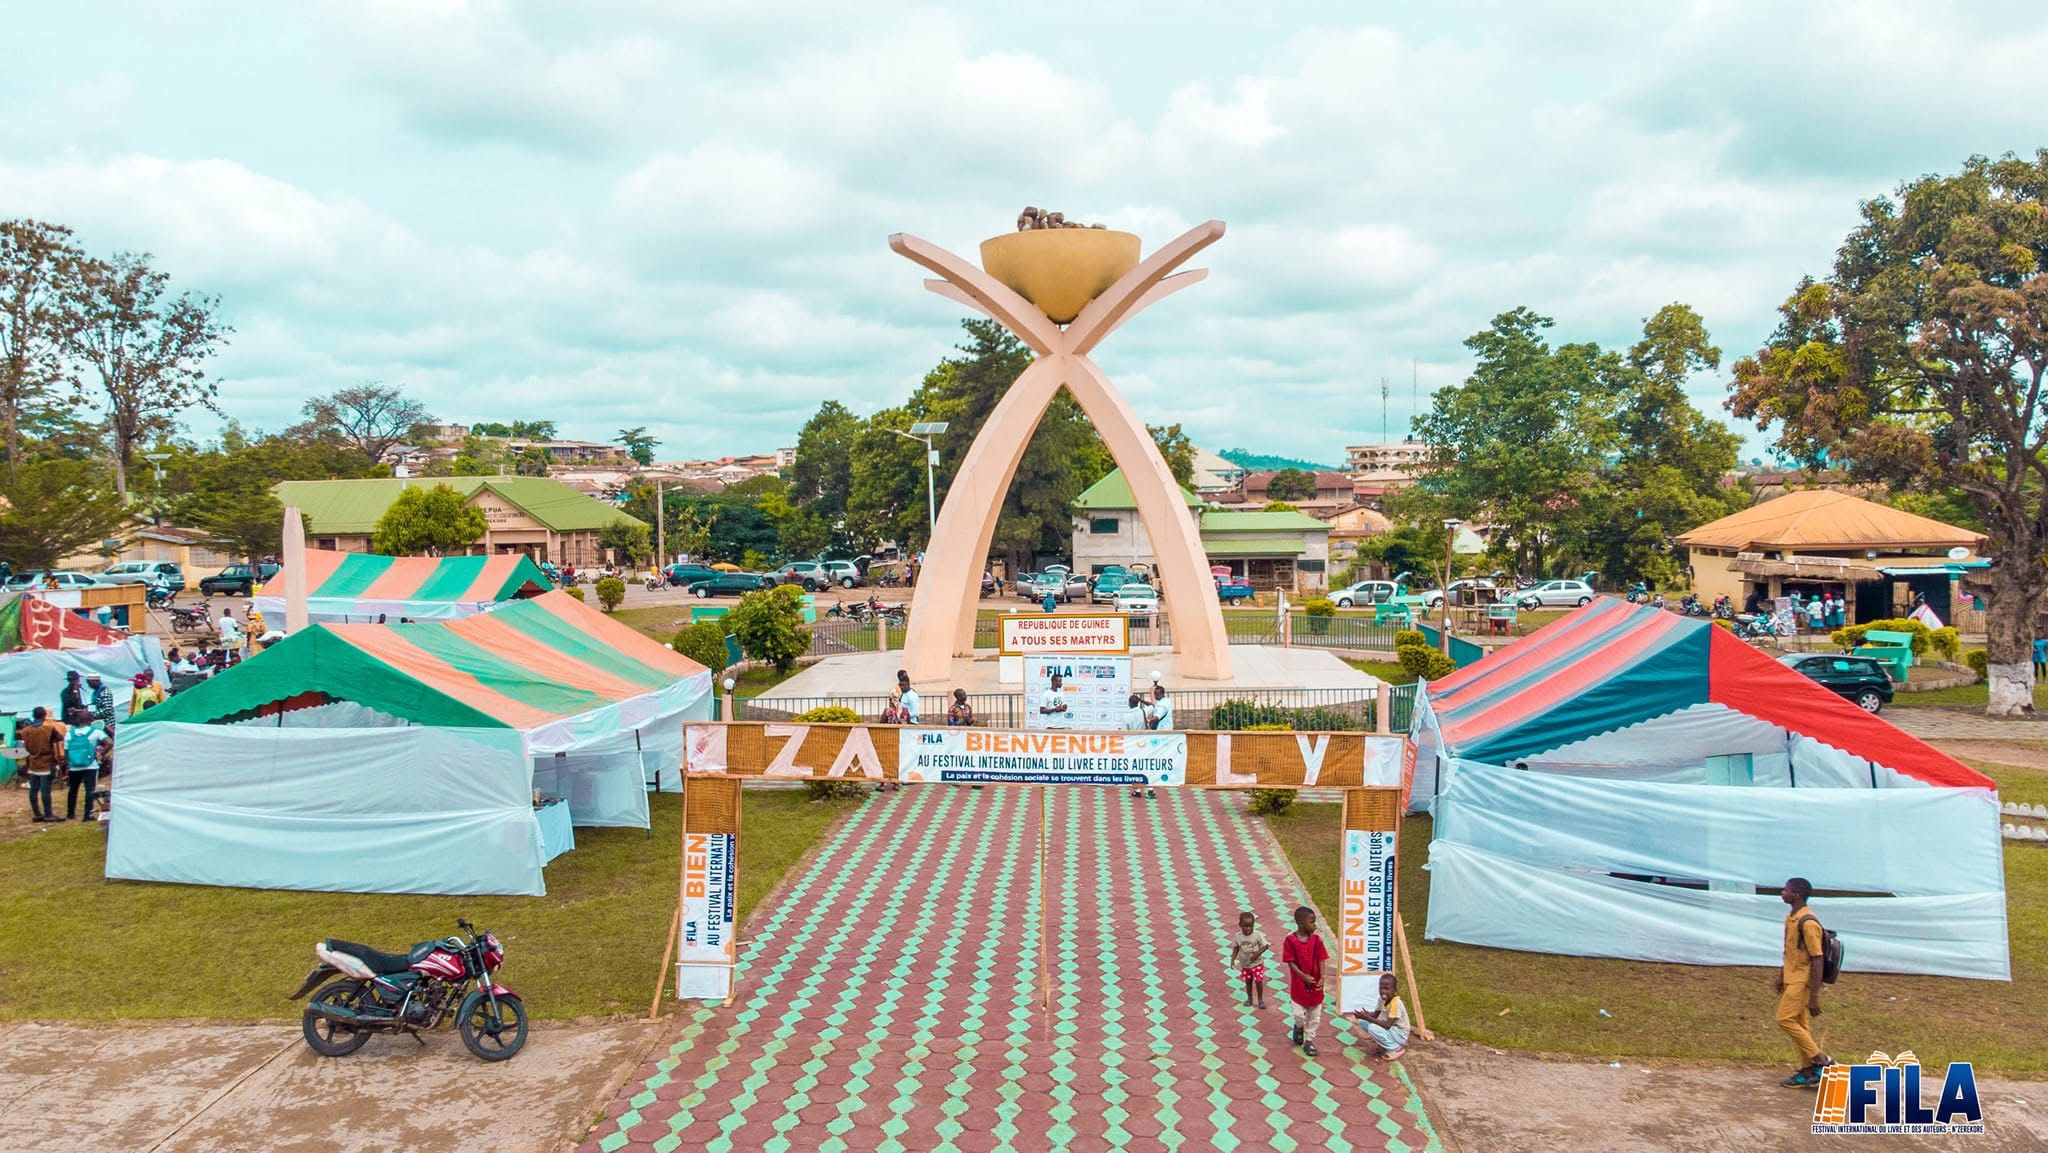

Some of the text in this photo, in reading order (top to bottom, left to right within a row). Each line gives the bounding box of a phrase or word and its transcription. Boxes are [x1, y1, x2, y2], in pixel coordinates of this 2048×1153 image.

[1018, 619, 1110, 630] REPUBLIQUE DE GUINEE
[1011, 635, 1116, 645] A TOUS SES MARTYRS
[966, 732, 1124, 754] BIENVENUE
[917, 754, 1173, 771] AU FESTIVAL INTERNATIONAL DU LIVRE ET DES AUTEURS
[956, 772, 972, 780] paix
[990, 773, 1023, 781] cohésion
[1112, 775, 1123, 783] les
[1124, 775, 1144, 783] livres
[727, 841, 735, 874] cohésion
[1369, 832, 1383, 873] AUTEURS
[686, 834, 708, 898] BIEN
[707, 833, 724, 946] AU FESTIVAL INTERNATIO
[727, 883, 733, 891] et
[1369, 876, 1382, 893] DES
[726, 892, 734, 907] paix
[1369, 896, 1382, 907] ET
[1385, 894, 1393, 911] dans
[726, 908, 732, 918] La
[1344, 879, 1365, 973] VENUE
[1368, 910, 1381, 937] LIVRE
[1385, 913, 1393, 944] trouvent
[1367, 940, 1380, 952] DU
[1386, 946, 1392, 954] se
